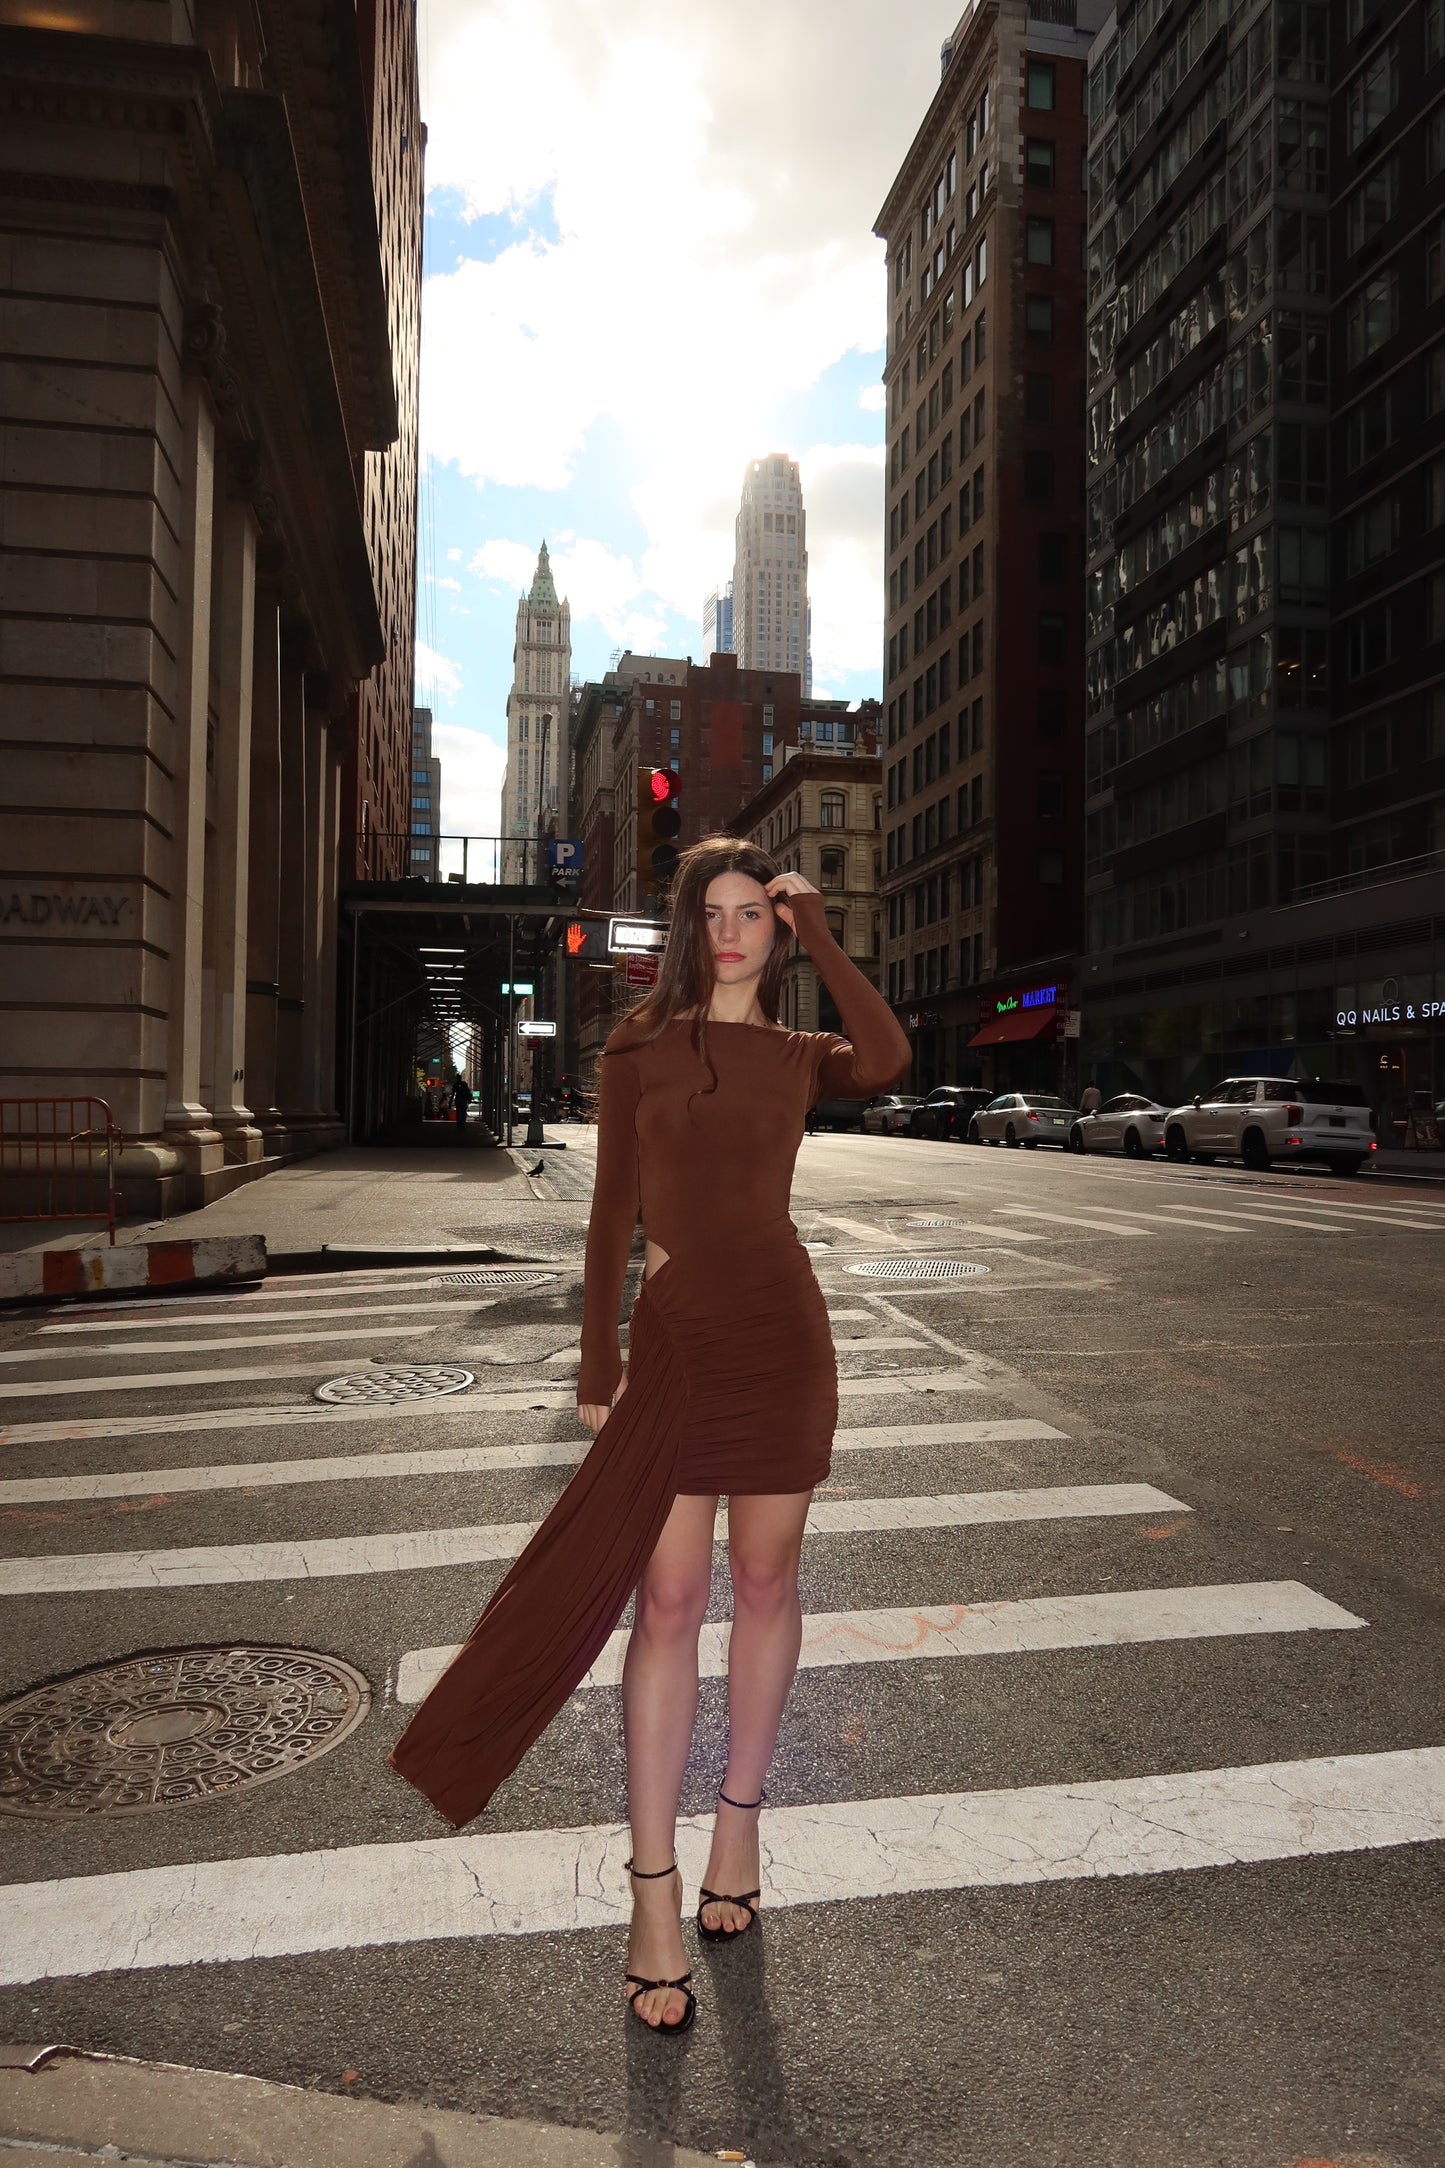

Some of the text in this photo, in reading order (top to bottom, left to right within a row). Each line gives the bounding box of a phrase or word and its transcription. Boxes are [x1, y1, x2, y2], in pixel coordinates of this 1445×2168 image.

[557, 843, 576, 865] P
[551, 867, 581, 877] PARK
[0, 893, 130, 925] ADWAY
[623, 930, 649, 943] ONE
[1022, 985, 1057, 1009] MARKET
[1336, 1001, 1445, 1026] QQ NAILS & SPA
